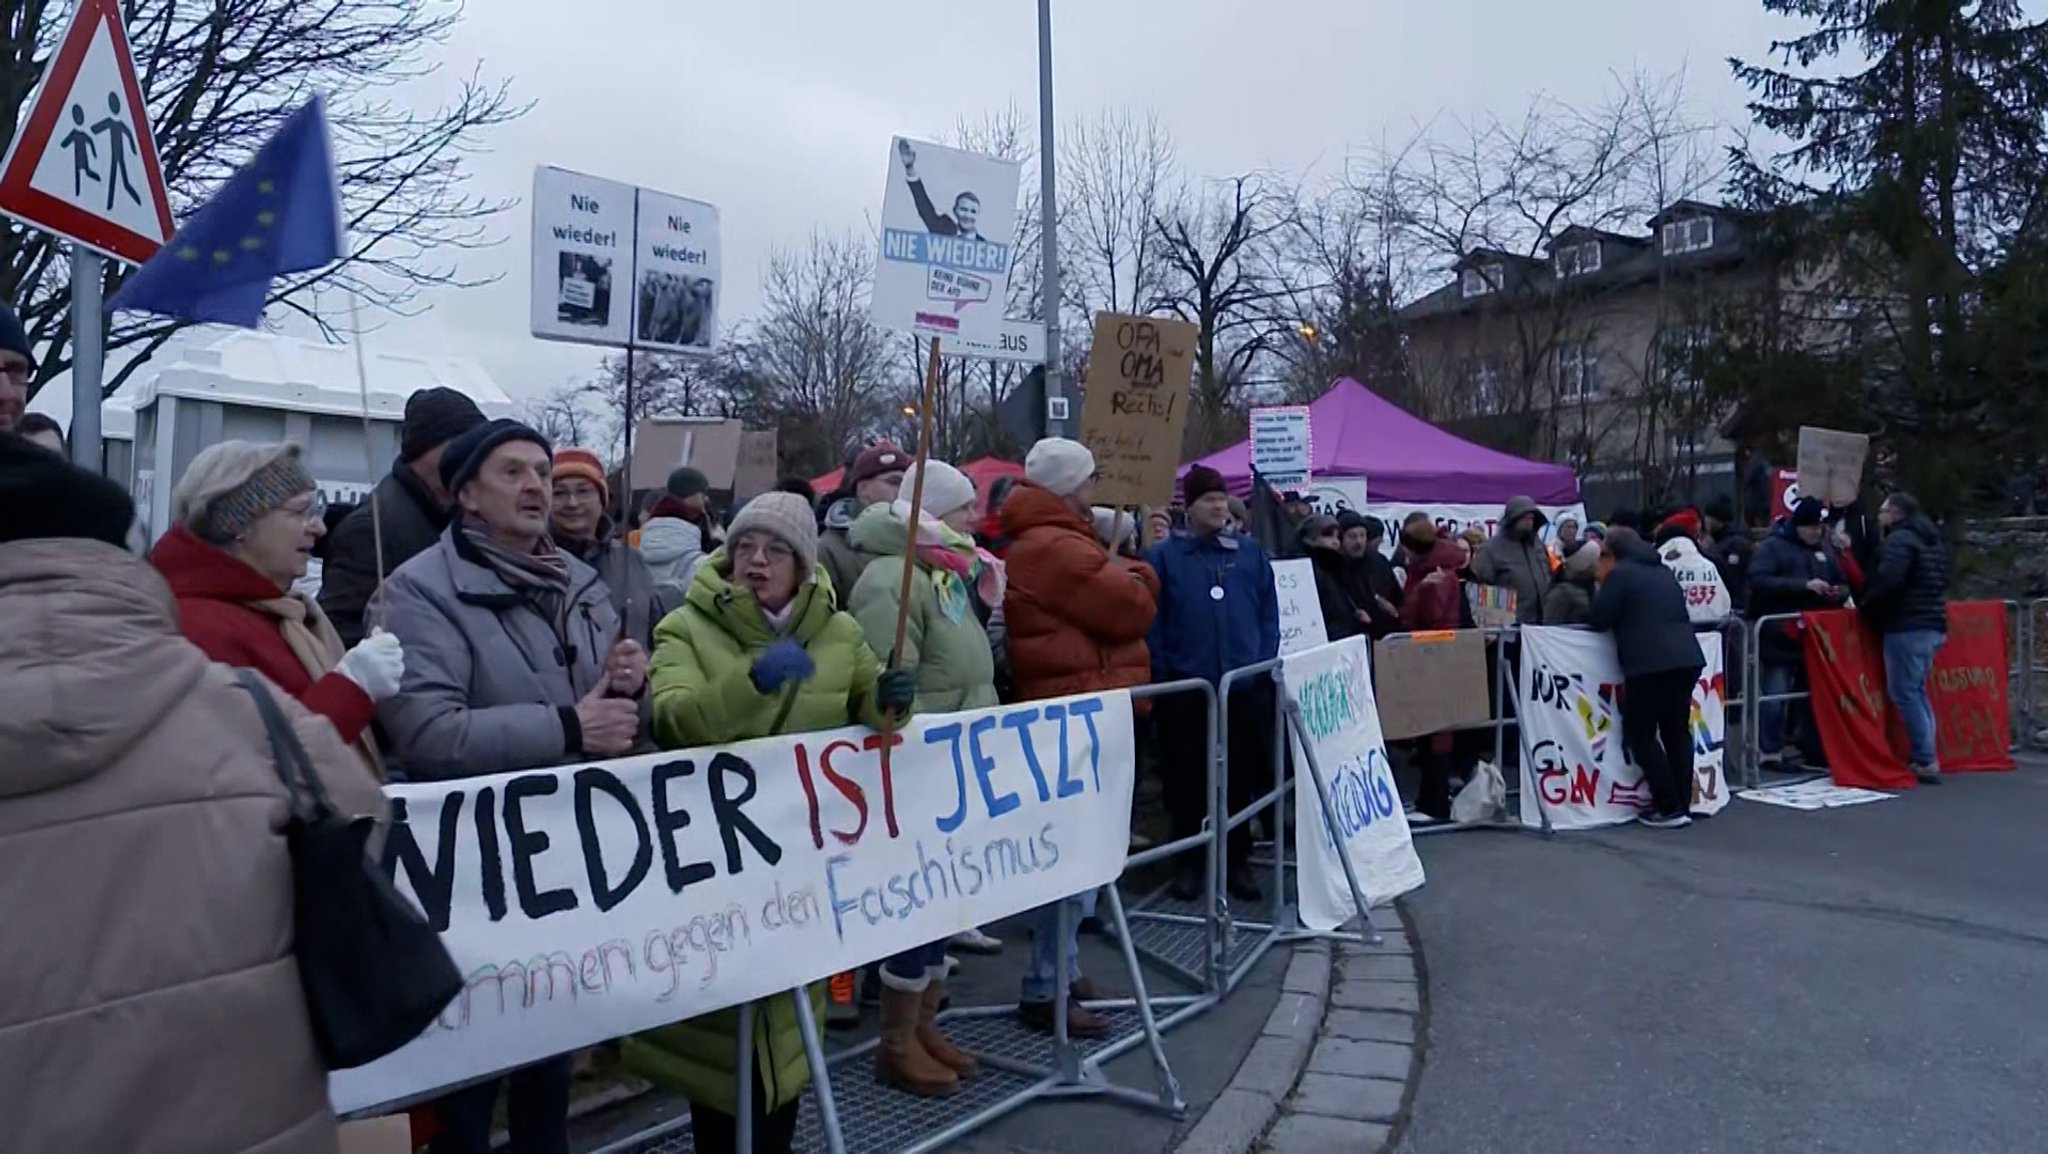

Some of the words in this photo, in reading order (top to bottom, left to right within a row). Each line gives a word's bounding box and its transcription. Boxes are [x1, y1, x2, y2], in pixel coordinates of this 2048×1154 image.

[571, 193, 600, 214] Nie
[553, 224, 617, 248] wieder!
[668, 214, 691, 234] Nie
[652, 244, 707, 265] wieder!
[886, 231, 918, 261] NIE
[926, 236, 1005, 272] WIEDER!
[1116, 321, 1161, 352] OPA
[1119, 351, 1165, 385] OMA
[794, 733, 904, 849] IST
[924, 697, 1104, 833] JETZT
[643, 900, 752, 1004] gegen
[760, 878, 821, 933] den
[825, 821, 1060, 945] Faschismus
